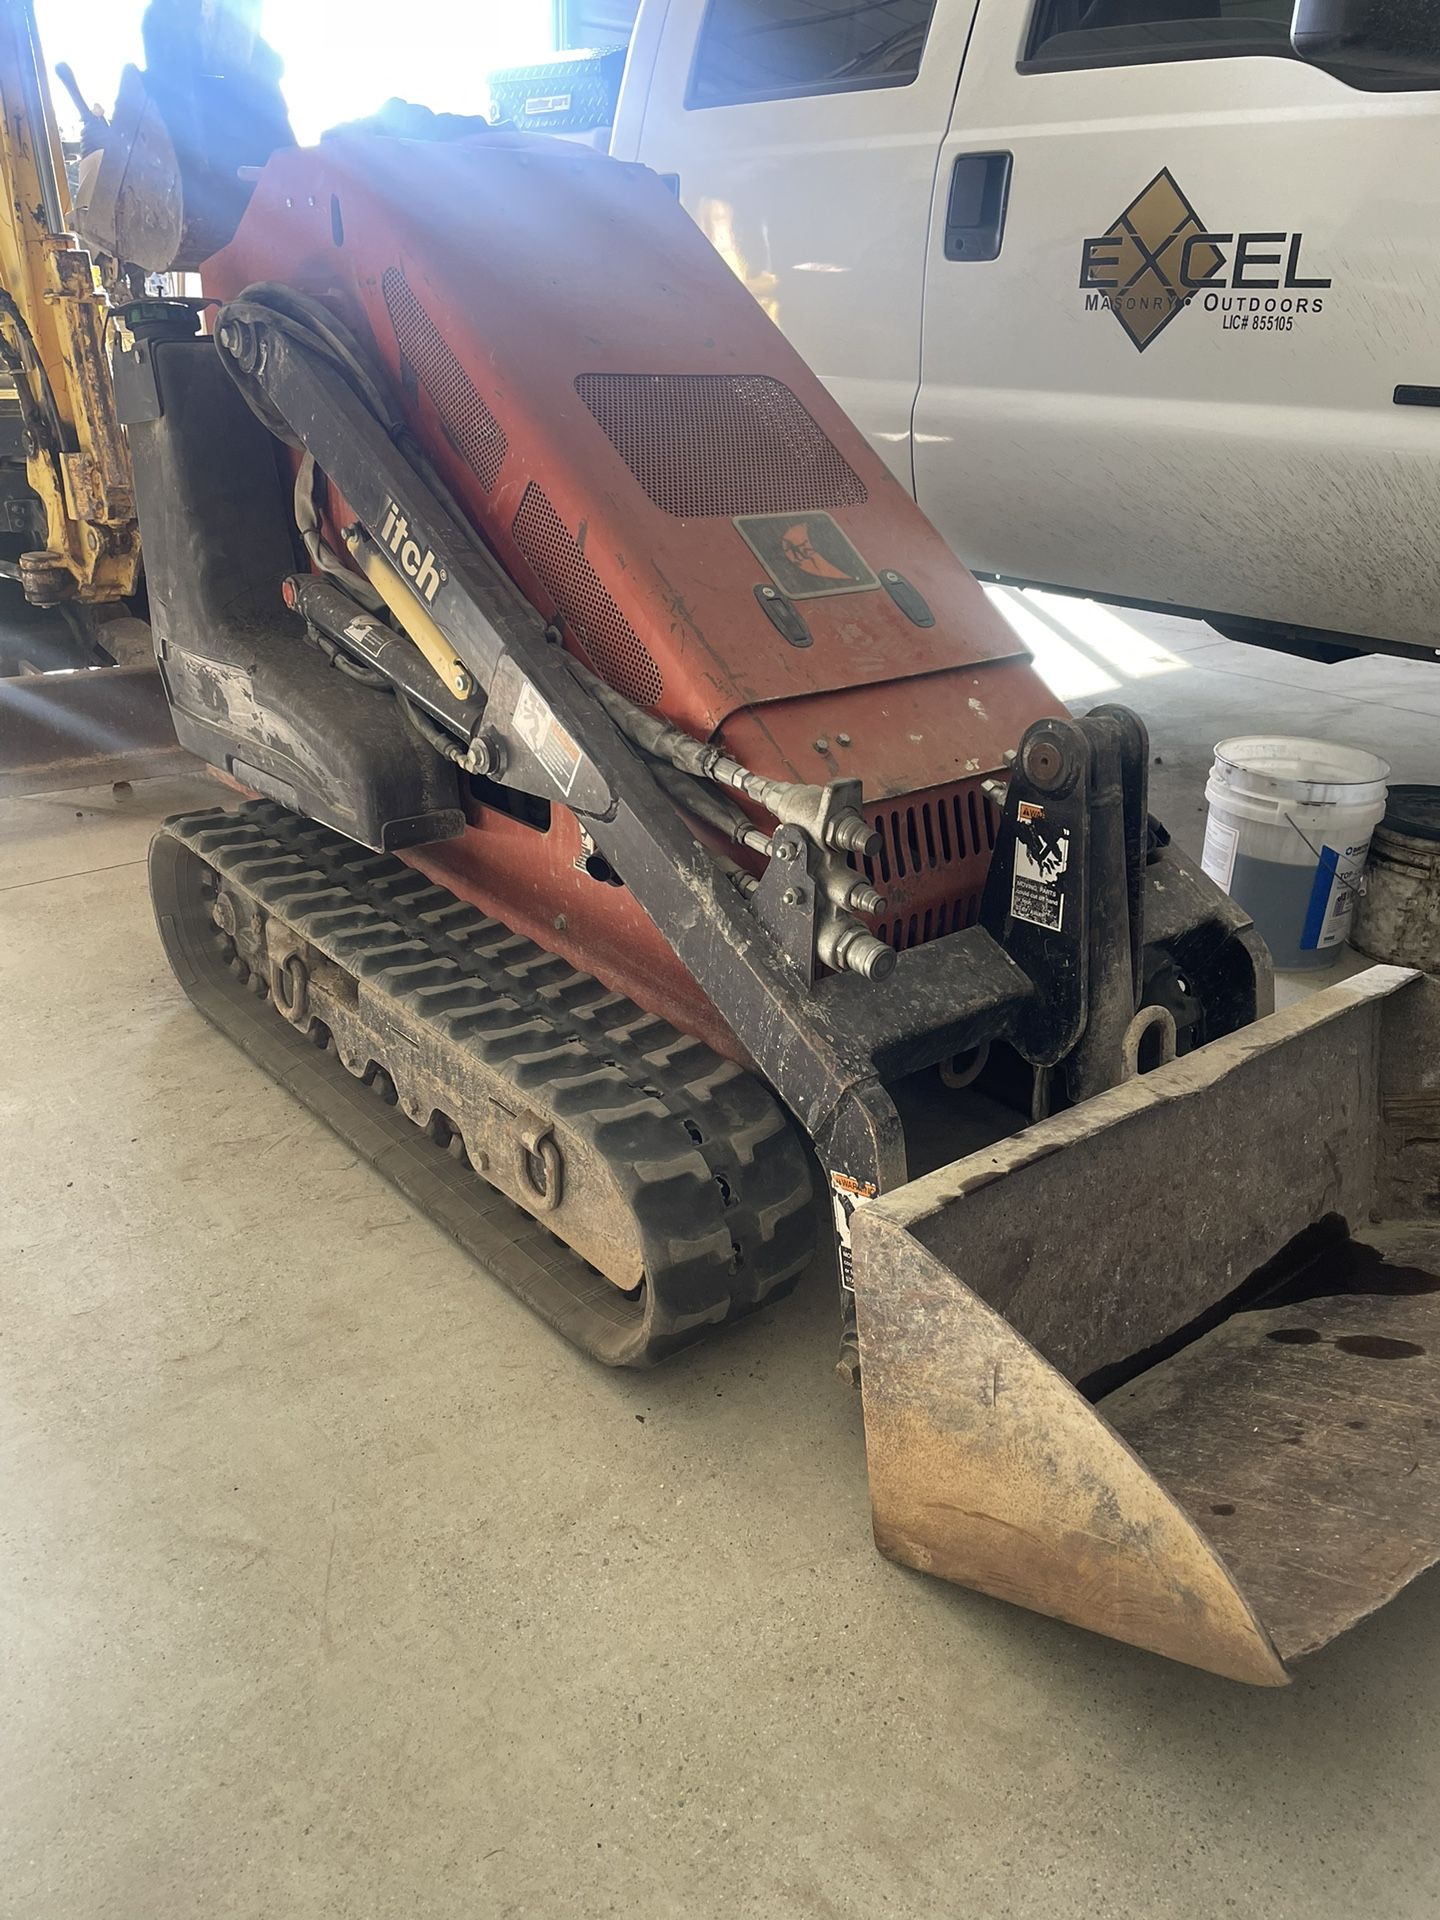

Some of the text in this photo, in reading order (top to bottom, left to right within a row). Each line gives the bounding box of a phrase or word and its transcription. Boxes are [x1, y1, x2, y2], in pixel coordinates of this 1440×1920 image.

[1079, 232, 1332, 289] EXCEL
[1085, 293, 1324, 313] MASONRY OUTDOORS
[1222, 315, 1294, 331] LIC# 855105
